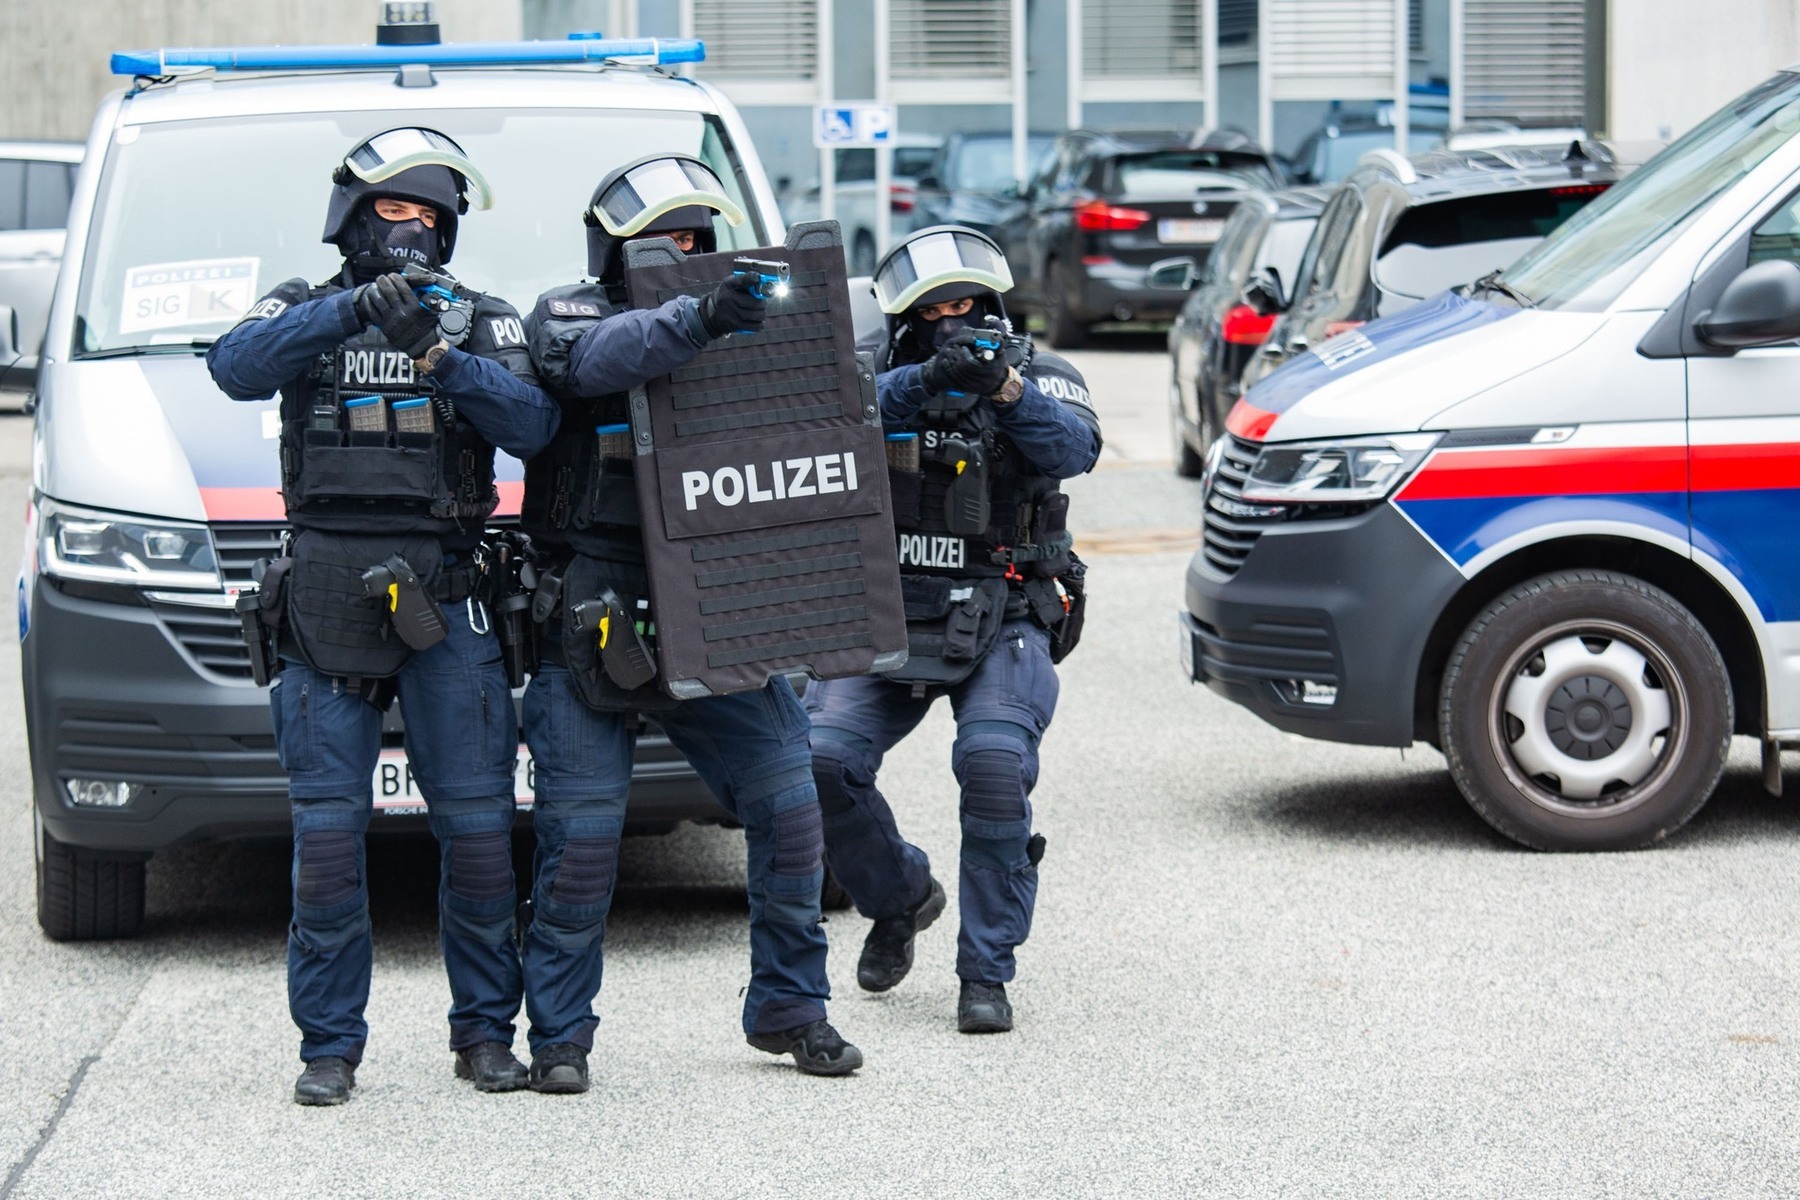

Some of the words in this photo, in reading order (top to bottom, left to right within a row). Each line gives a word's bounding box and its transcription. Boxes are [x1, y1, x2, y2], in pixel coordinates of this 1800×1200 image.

[136, 267, 232, 286] POLIZEI
[136, 294, 180, 318] SIG
[208, 289, 232, 311] K
[553, 301, 596, 315] SIG
[344, 350, 415, 384] POLIZEI
[682, 452, 859, 511] POLIZEI
[899, 534, 965, 569] POLIZEI
